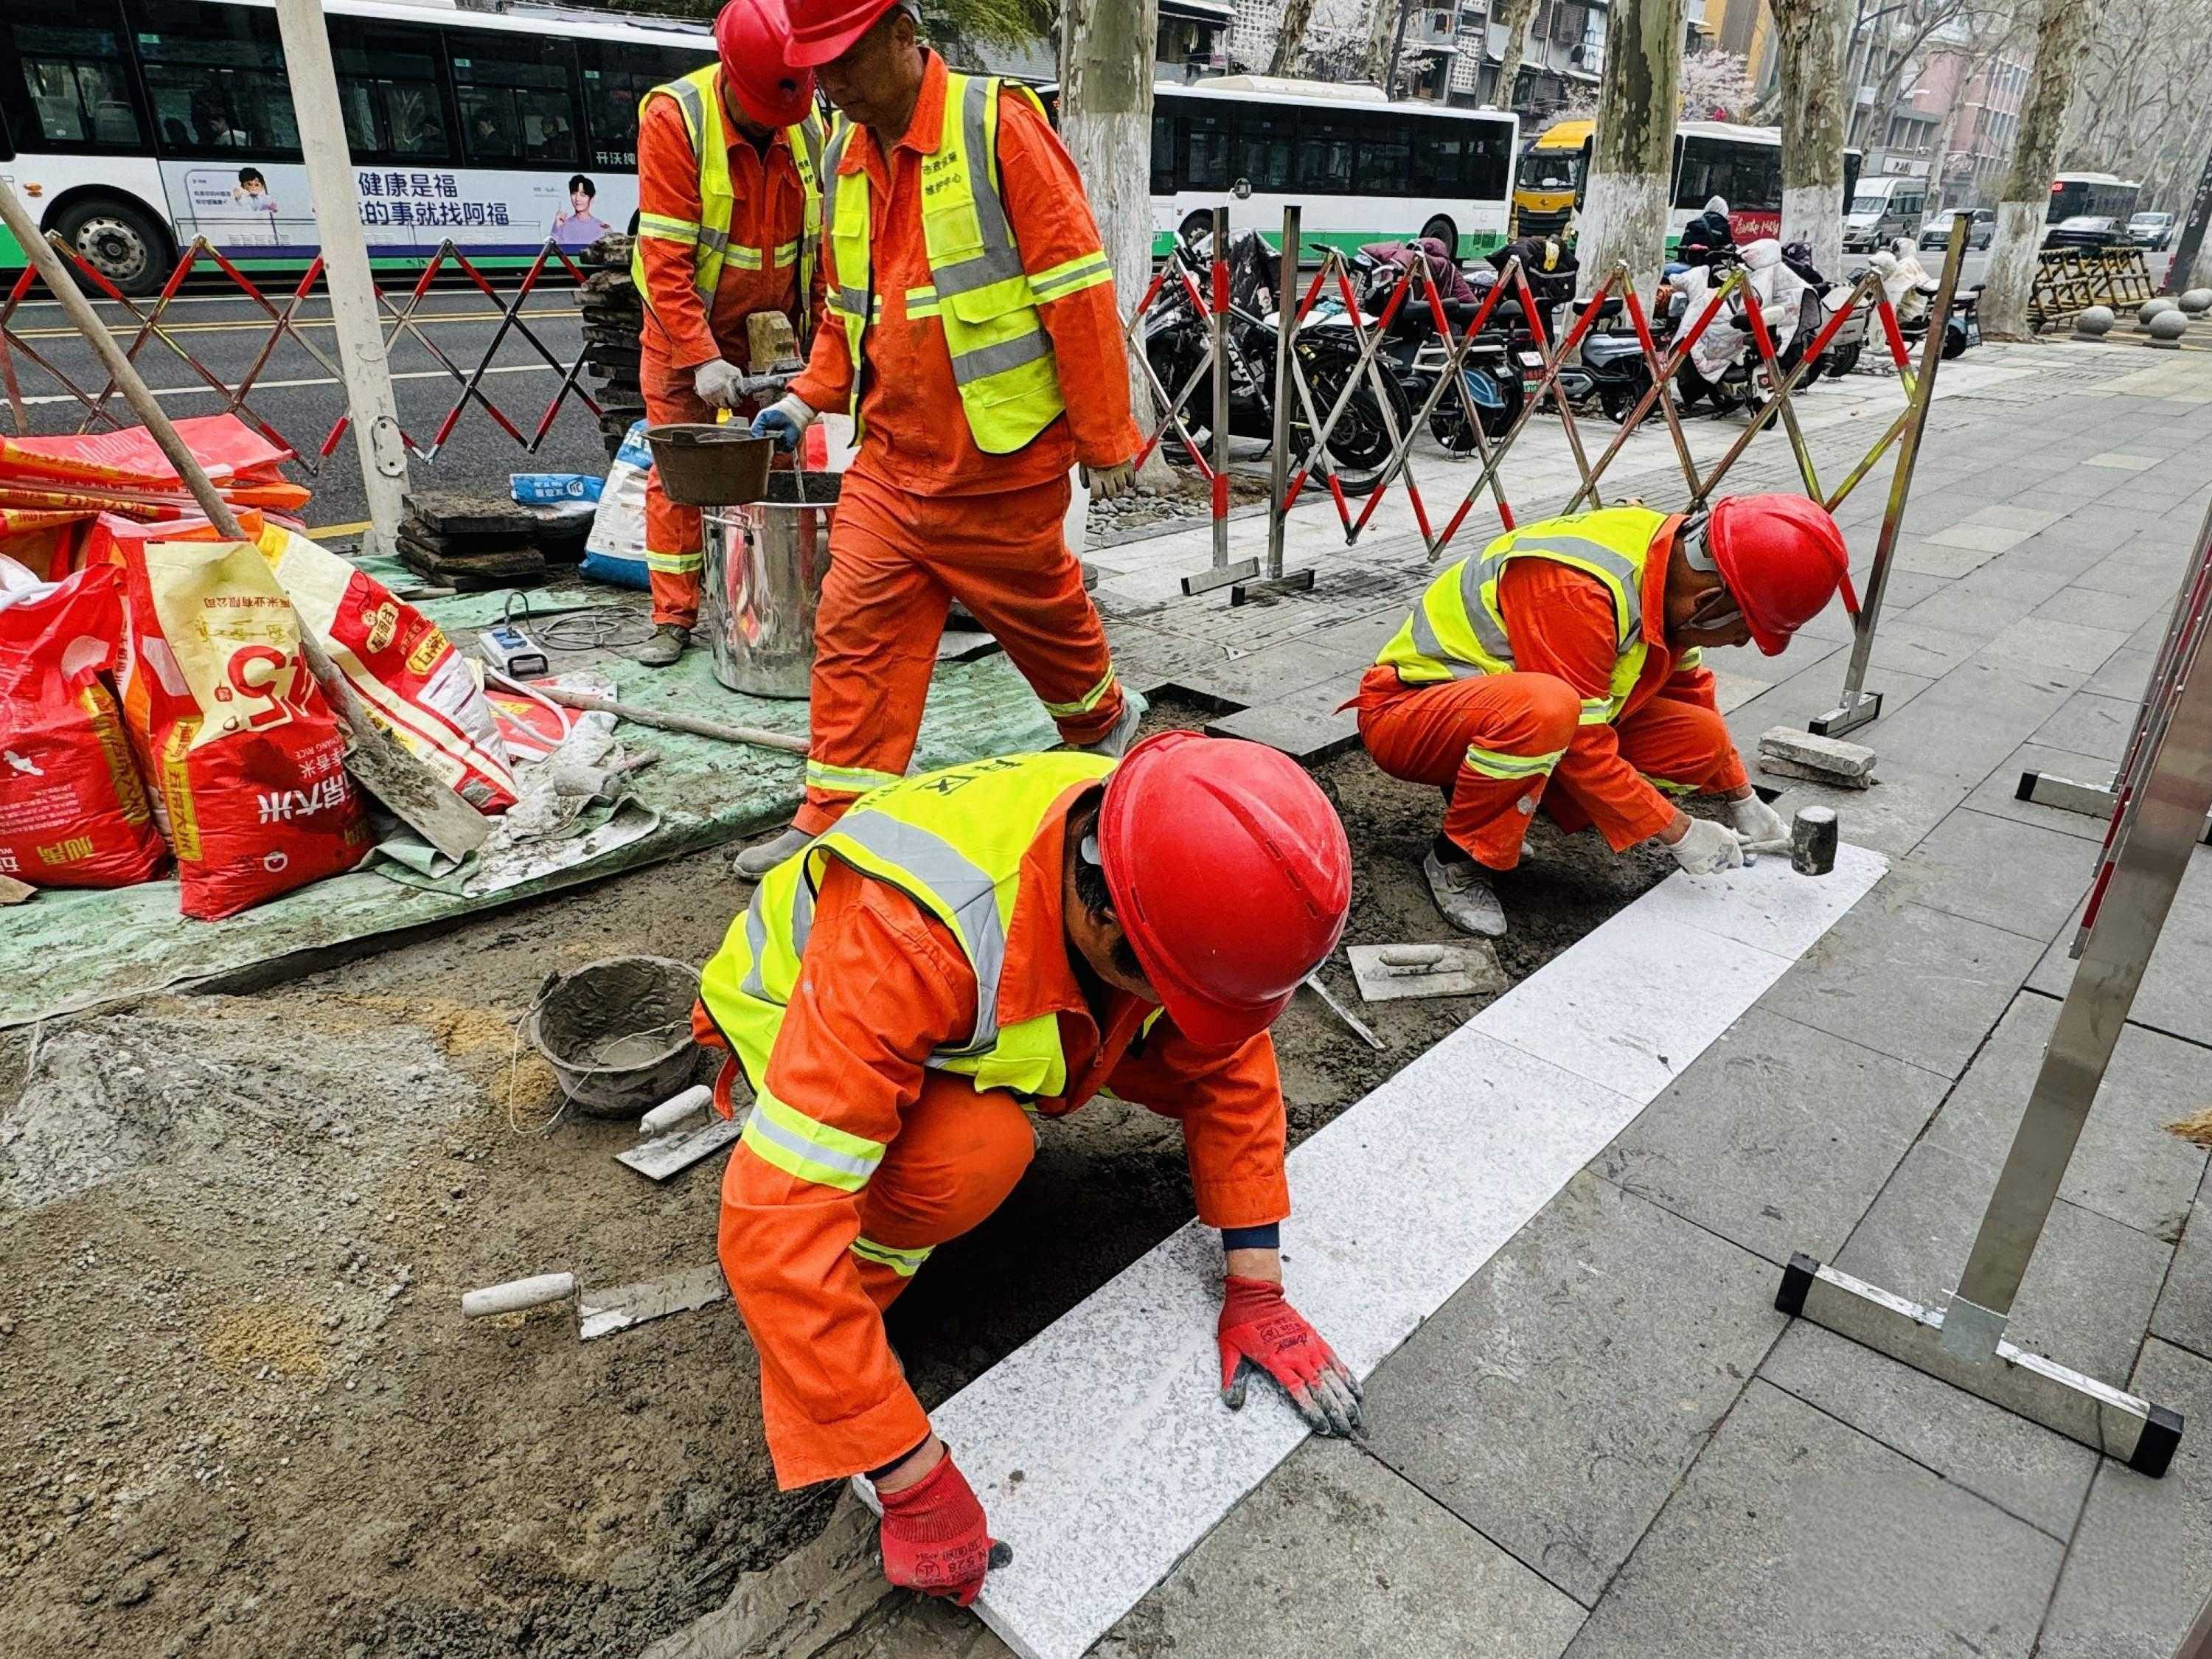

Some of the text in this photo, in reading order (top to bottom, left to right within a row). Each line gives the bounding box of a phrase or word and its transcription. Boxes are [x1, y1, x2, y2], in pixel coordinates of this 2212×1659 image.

[358, 172, 458, 198] 健康是福
[256, 771, 352, 824] 常大米
